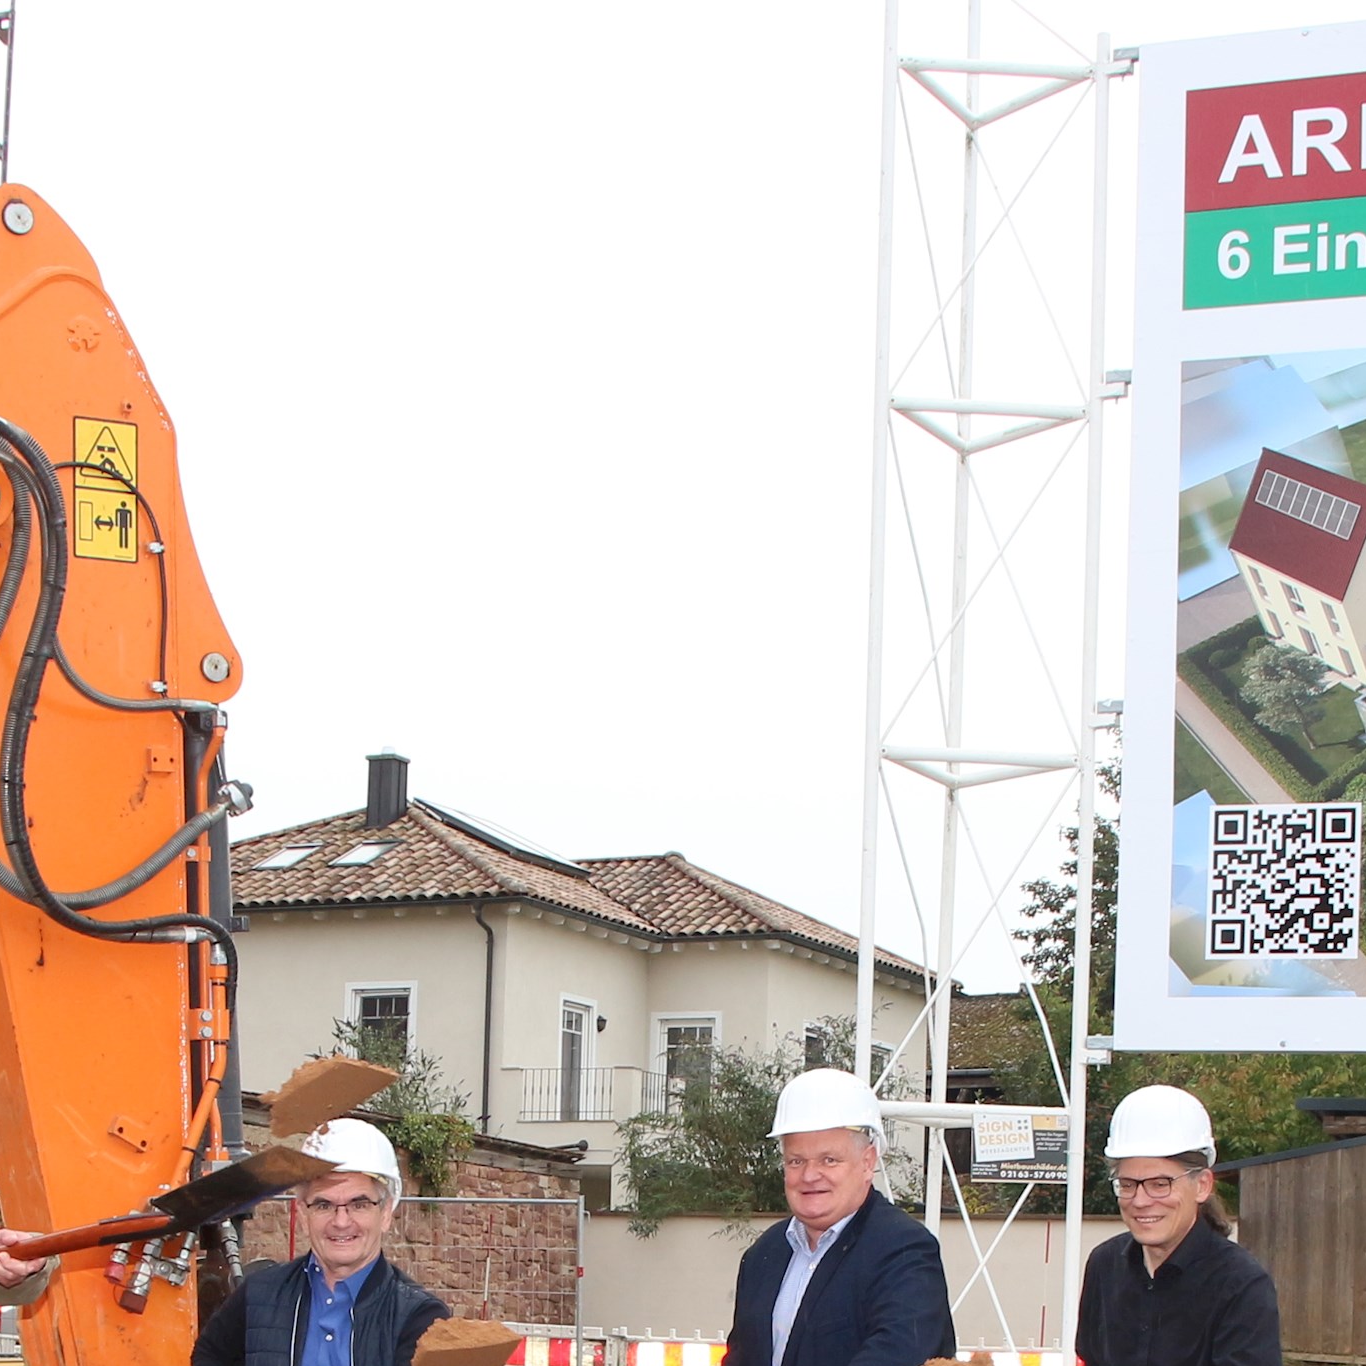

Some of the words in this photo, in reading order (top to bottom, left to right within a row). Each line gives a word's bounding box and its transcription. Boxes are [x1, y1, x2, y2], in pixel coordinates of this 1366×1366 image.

[1217, 229, 1251, 280] 6
[978, 1121, 1013, 1134] SIGN
[979, 1133, 1029, 1146] DESIGN
